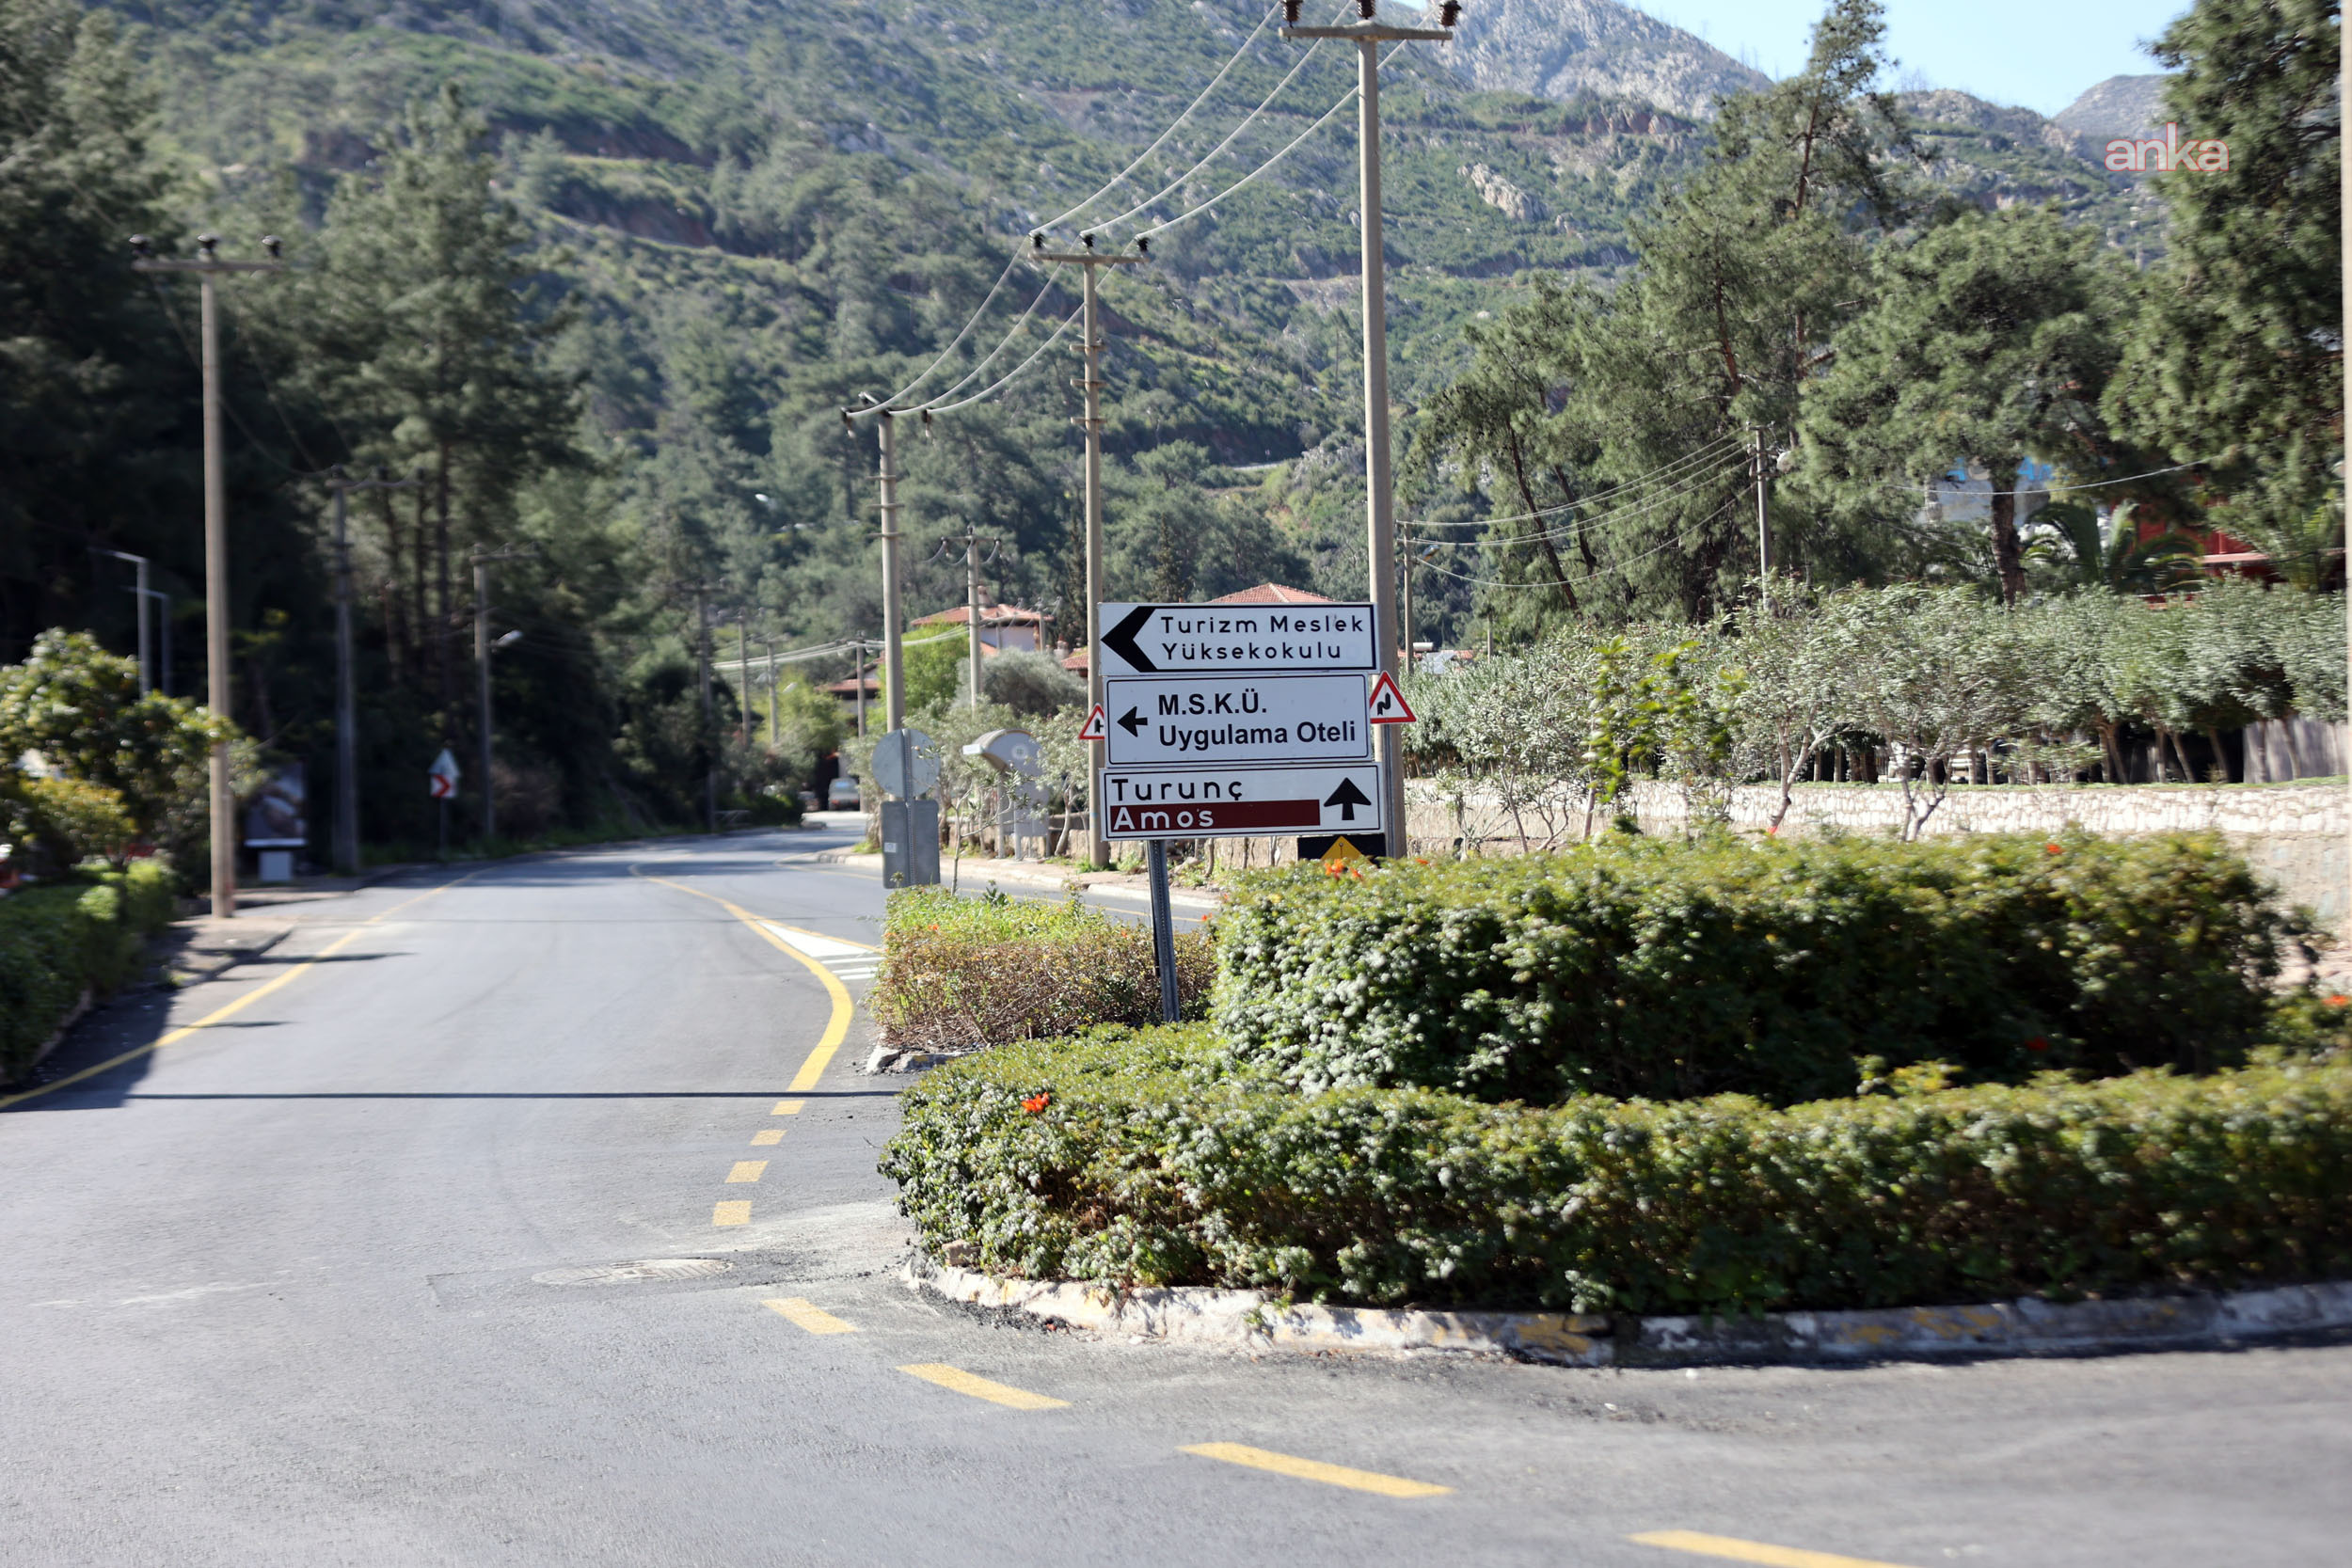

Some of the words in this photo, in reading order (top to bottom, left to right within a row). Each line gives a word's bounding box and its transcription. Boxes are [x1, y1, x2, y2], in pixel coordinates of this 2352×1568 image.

[1160, 615, 1258, 634] Turizm
[1270, 614, 1363, 633] Meslek
[1161, 641, 1341, 660] Yüksekokulu
[1158, 688, 1267, 716] M.S.K.Ü.
[1159, 723, 1288, 752] Uygulama
[1296, 720, 1356, 743] Oteli
[1111, 778, 1243, 801] Turunç
[1113, 806, 1214, 831] Amos
